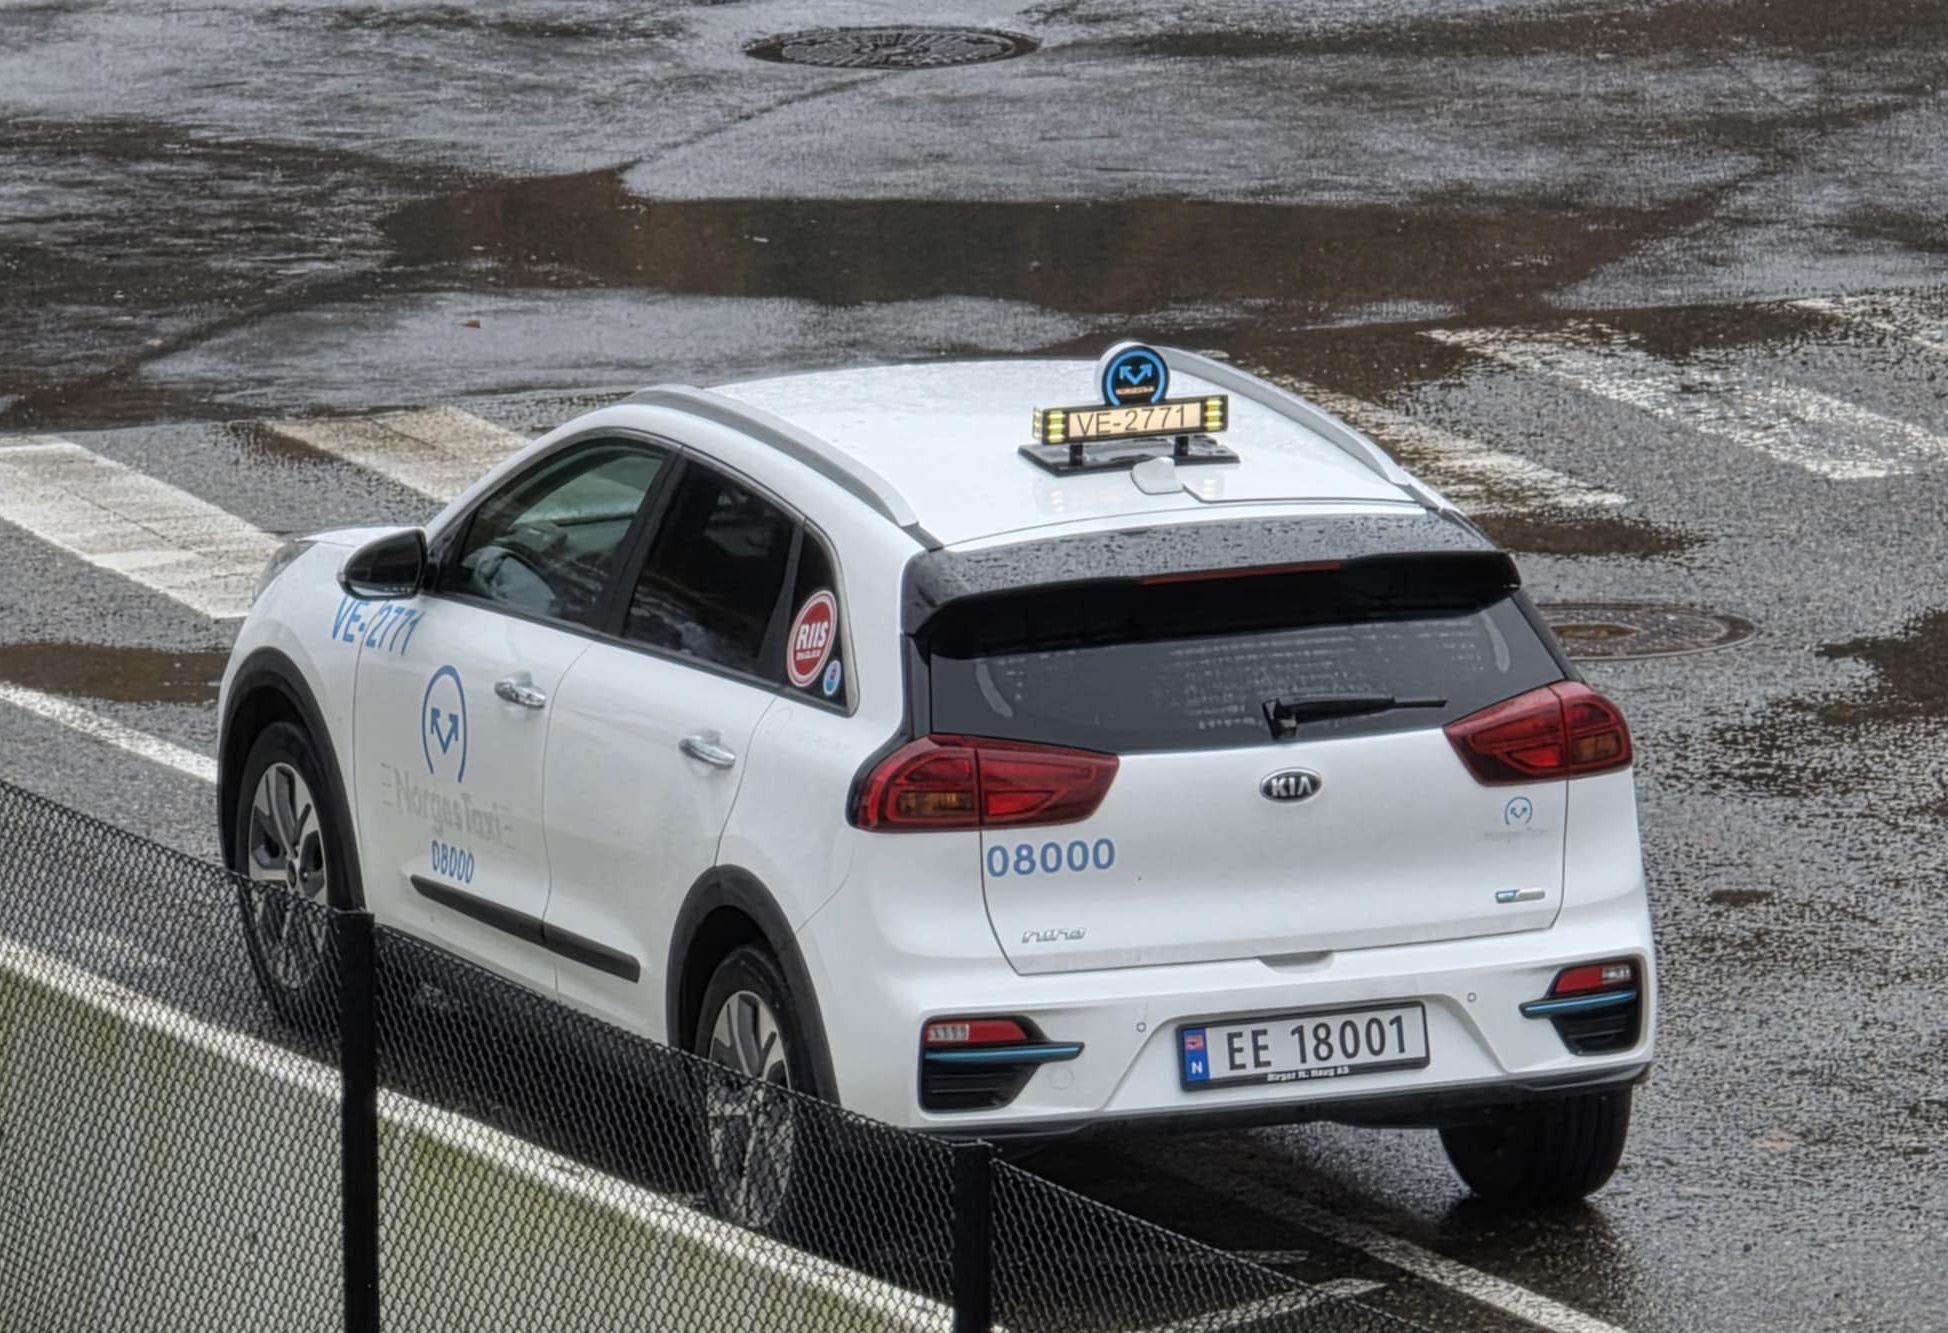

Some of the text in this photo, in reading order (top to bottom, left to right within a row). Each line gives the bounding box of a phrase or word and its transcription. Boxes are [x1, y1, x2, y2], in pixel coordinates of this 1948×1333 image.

[1076, 404, 1186, 435] VE-2771
[331, 594, 426, 657] VE-2771
[1271, 775, 1313, 797] KIA
[431, 839, 475, 884] 08000
[986, 838, 1116, 878] 08000
[1226, 1014, 1407, 1071] EE 18001
[1190, 1061, 1204, 1075] N
